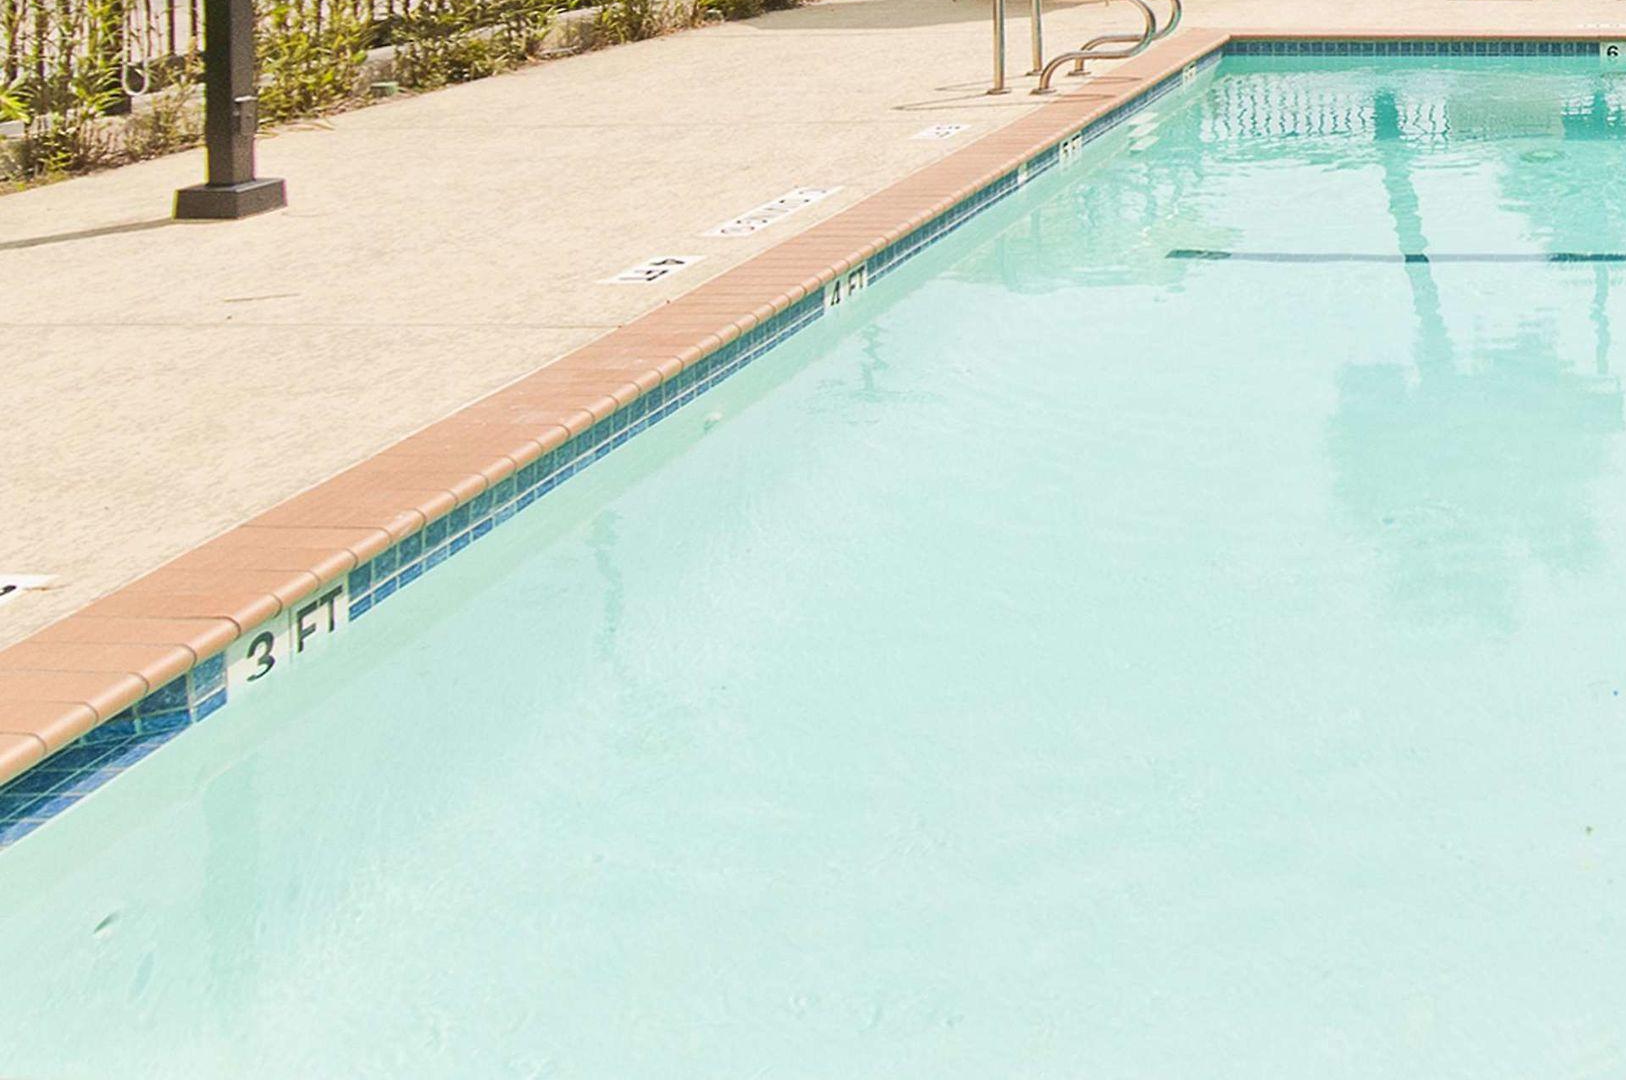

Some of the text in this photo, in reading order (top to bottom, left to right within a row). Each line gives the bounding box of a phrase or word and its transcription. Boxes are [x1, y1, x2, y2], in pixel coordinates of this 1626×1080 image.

[830, 264, 865, 306] 4 FT
[246, 584, 343, 682] 3 FT
